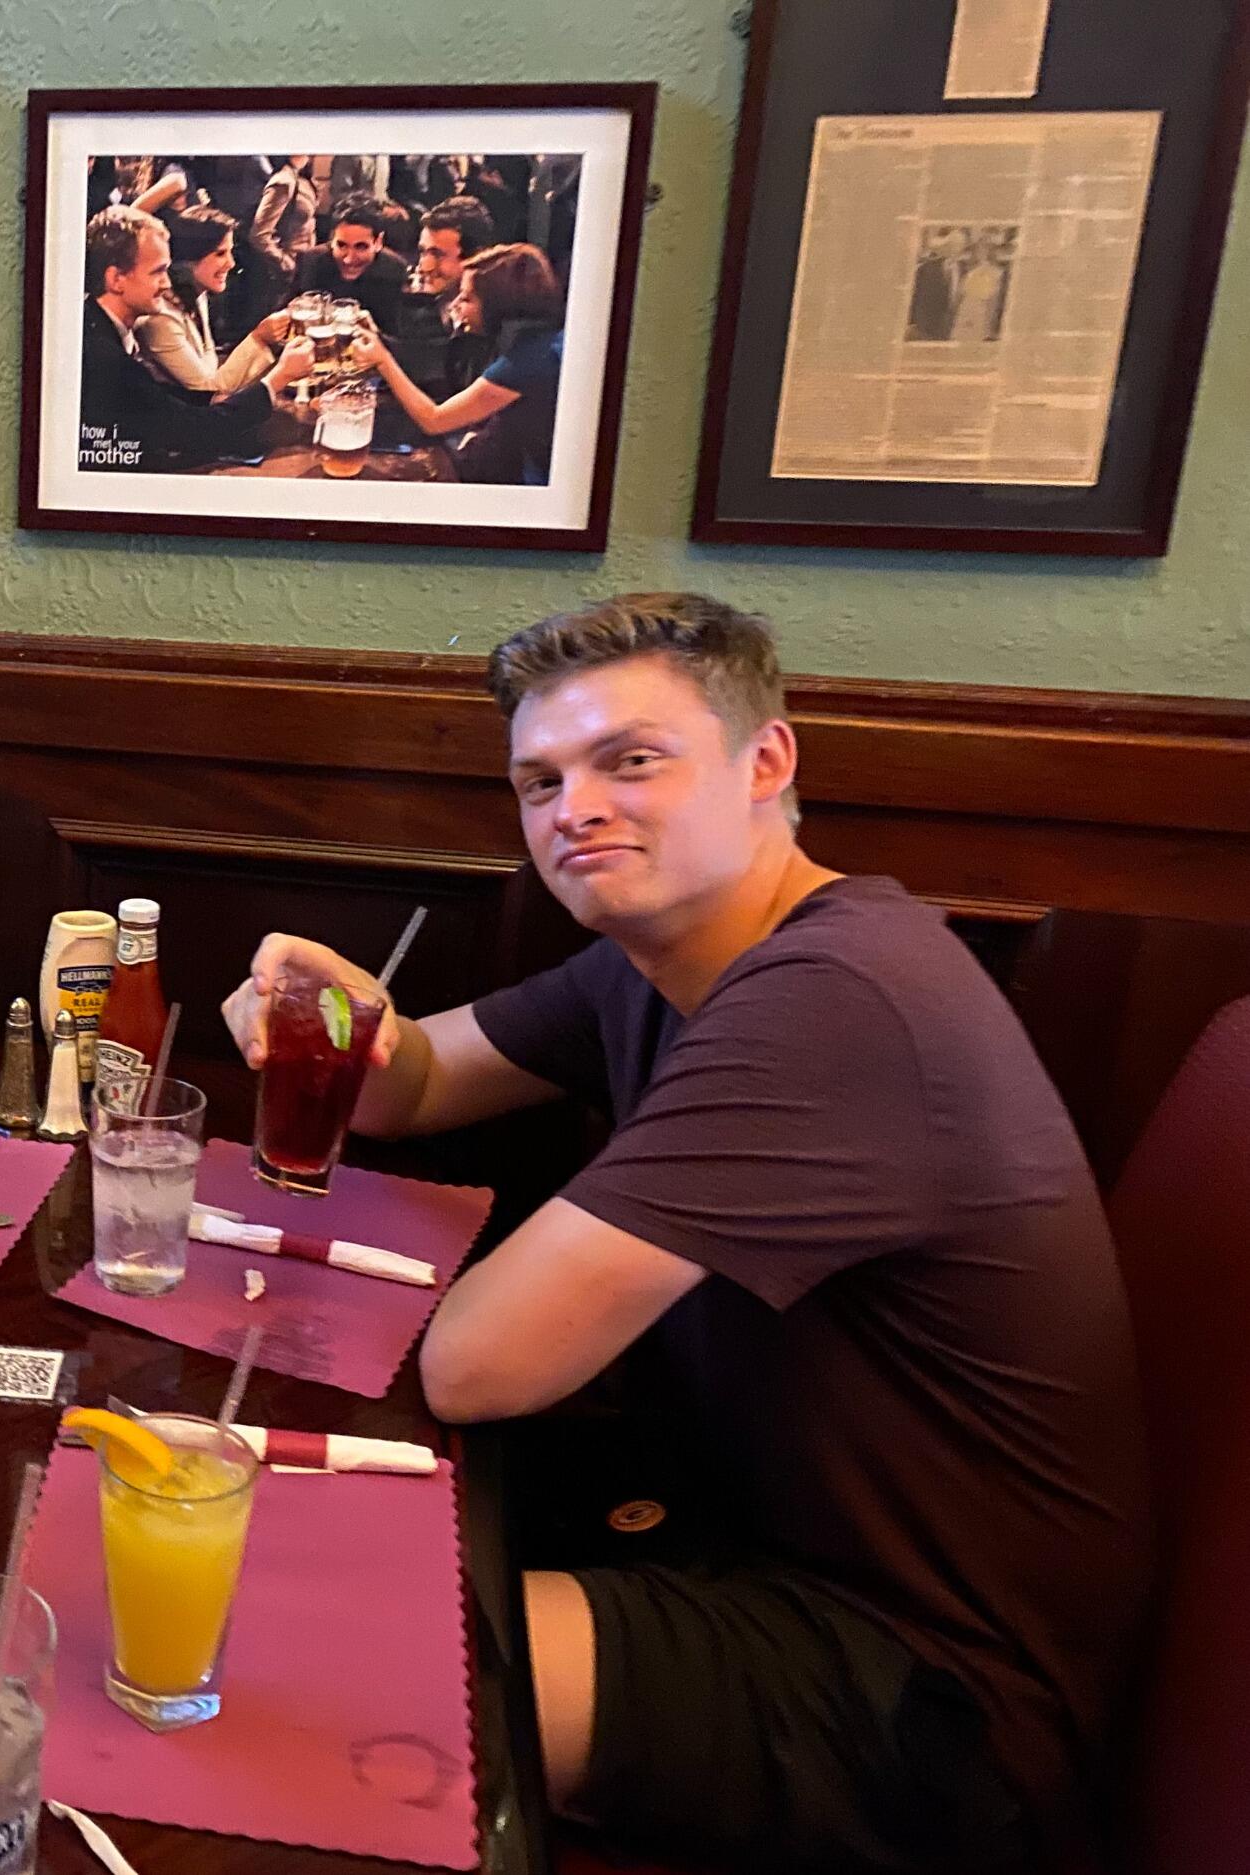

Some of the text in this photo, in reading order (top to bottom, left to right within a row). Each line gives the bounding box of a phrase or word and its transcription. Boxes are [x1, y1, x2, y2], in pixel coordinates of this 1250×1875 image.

[81, 423, 118, 440] how i
[117, 440, 141, 452] your
[79, 448, 143, 464] mother
